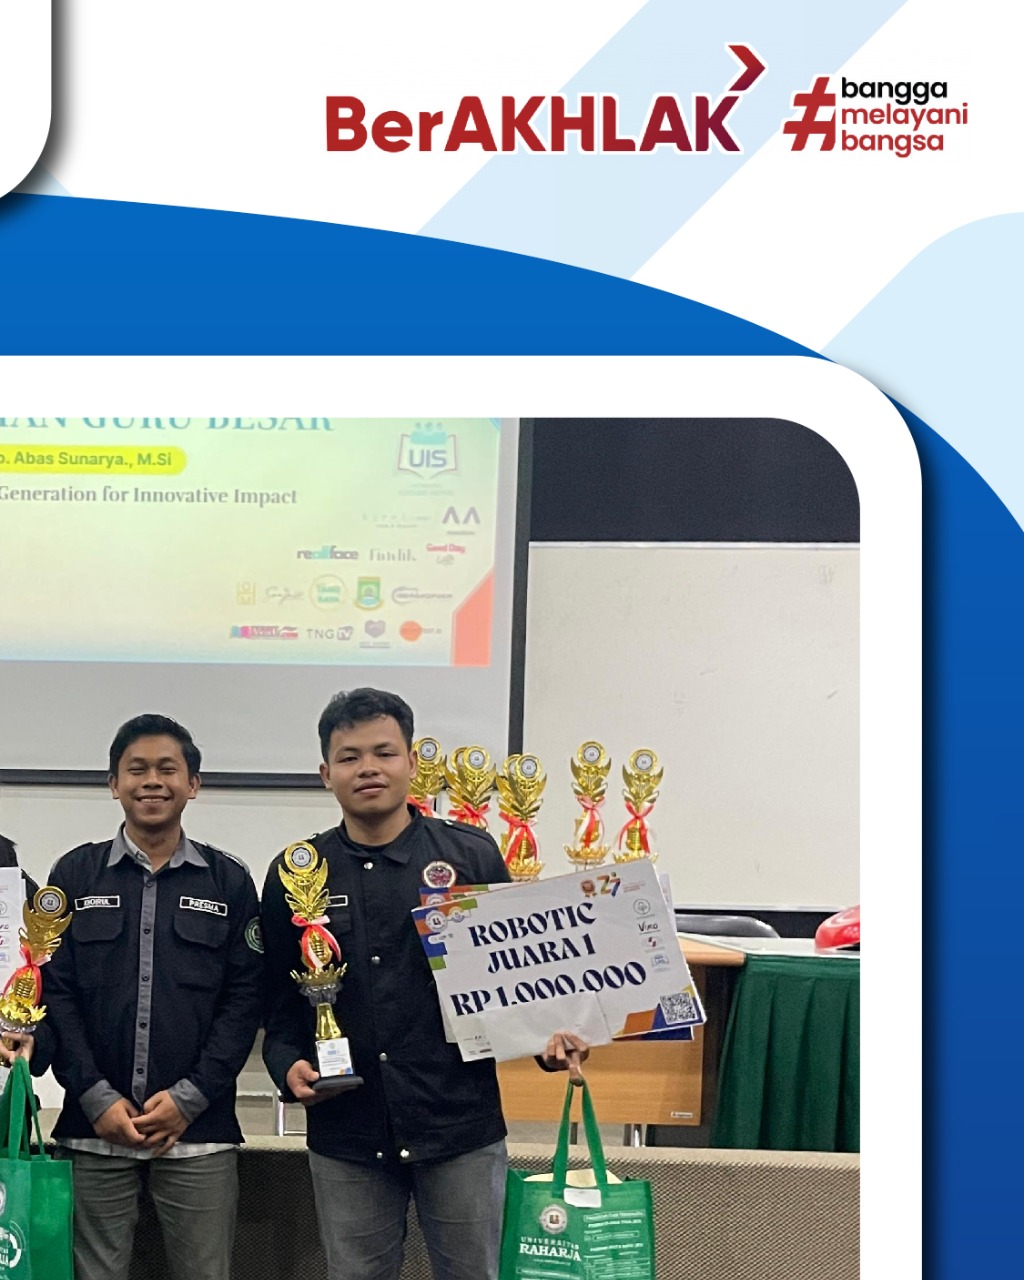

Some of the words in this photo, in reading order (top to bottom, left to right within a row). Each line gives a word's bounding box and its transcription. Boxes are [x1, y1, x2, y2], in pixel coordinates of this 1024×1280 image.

[14, 450, 54, 465] Abas
[137, 452, 173, 466] M.Si
[409, 449, 448, 468] UIS
[102, 485, 129, 503] for
[133, 487, 228, 504] Innovative
[234, 488, 298, 508] Impact
[467, 902, 597, 947] ROBOTIC
[487, 936, 582, 974] JUARA
[581, 933, 596, 955] 1
[450, 989, 492, 1017] RP
[495, 961, 647, 1008] 1.000.000
[519, 1242, 582, 1262] RAHARJA
